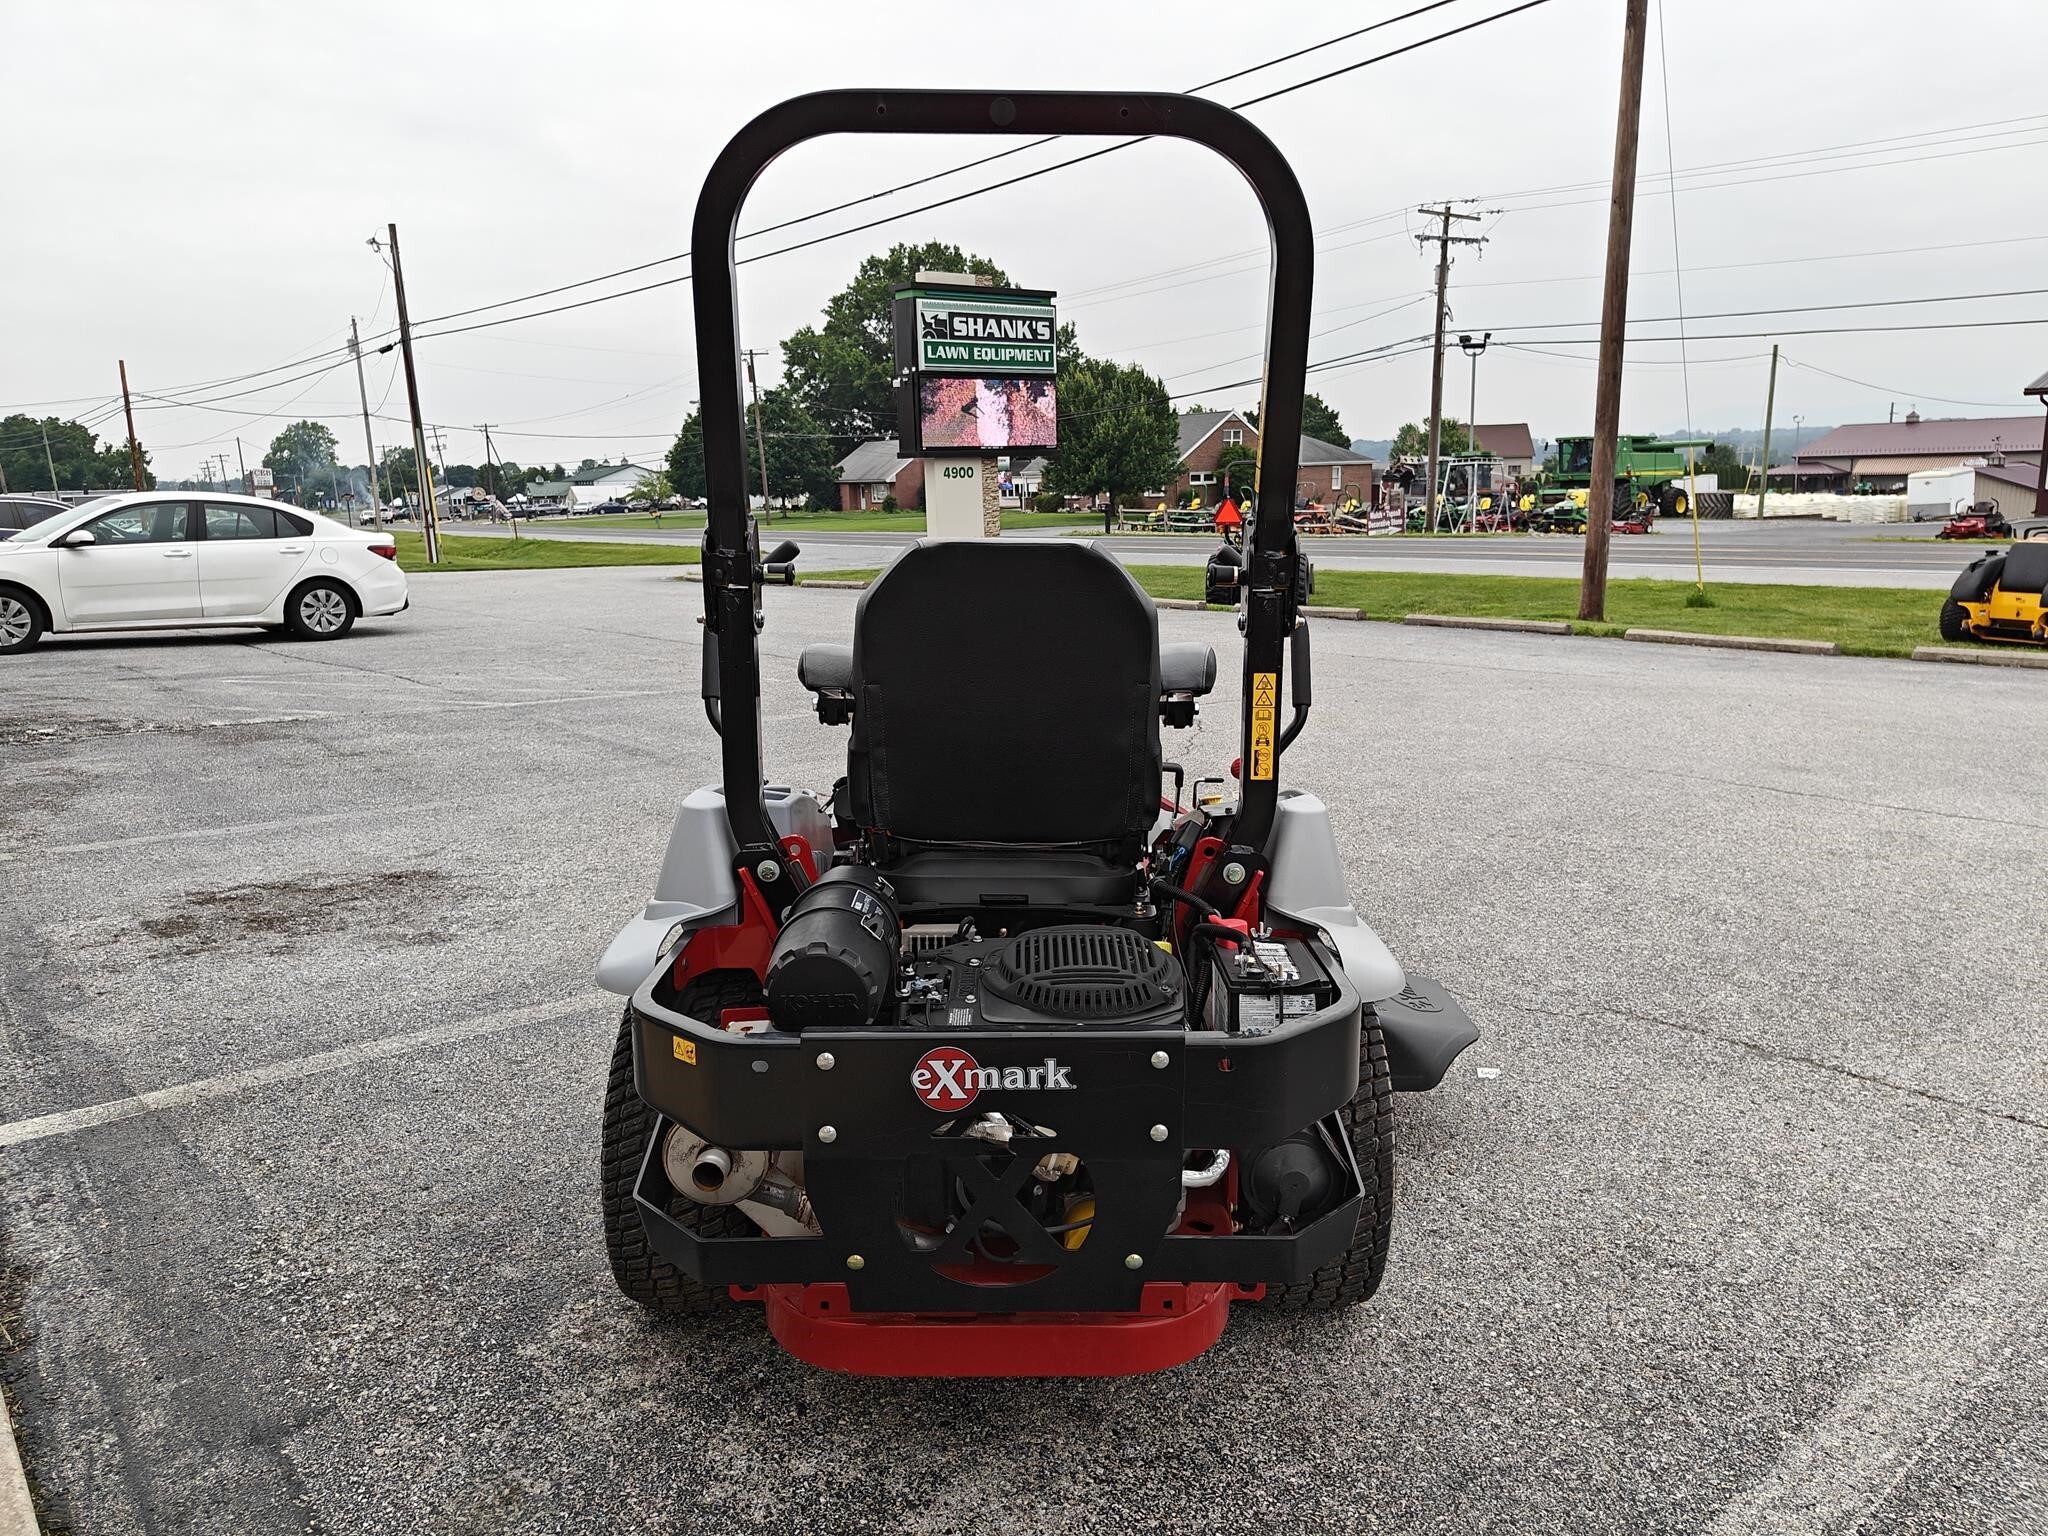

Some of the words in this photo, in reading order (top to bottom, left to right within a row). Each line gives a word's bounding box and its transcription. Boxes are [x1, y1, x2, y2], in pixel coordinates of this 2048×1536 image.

[953, 317, 1051, 339] SHANK'S
[927, 345, 969, 360] LAWN
[973, 347, 1051, 362] EQUIPMENT
[943, 466, 974, 479] 4900
